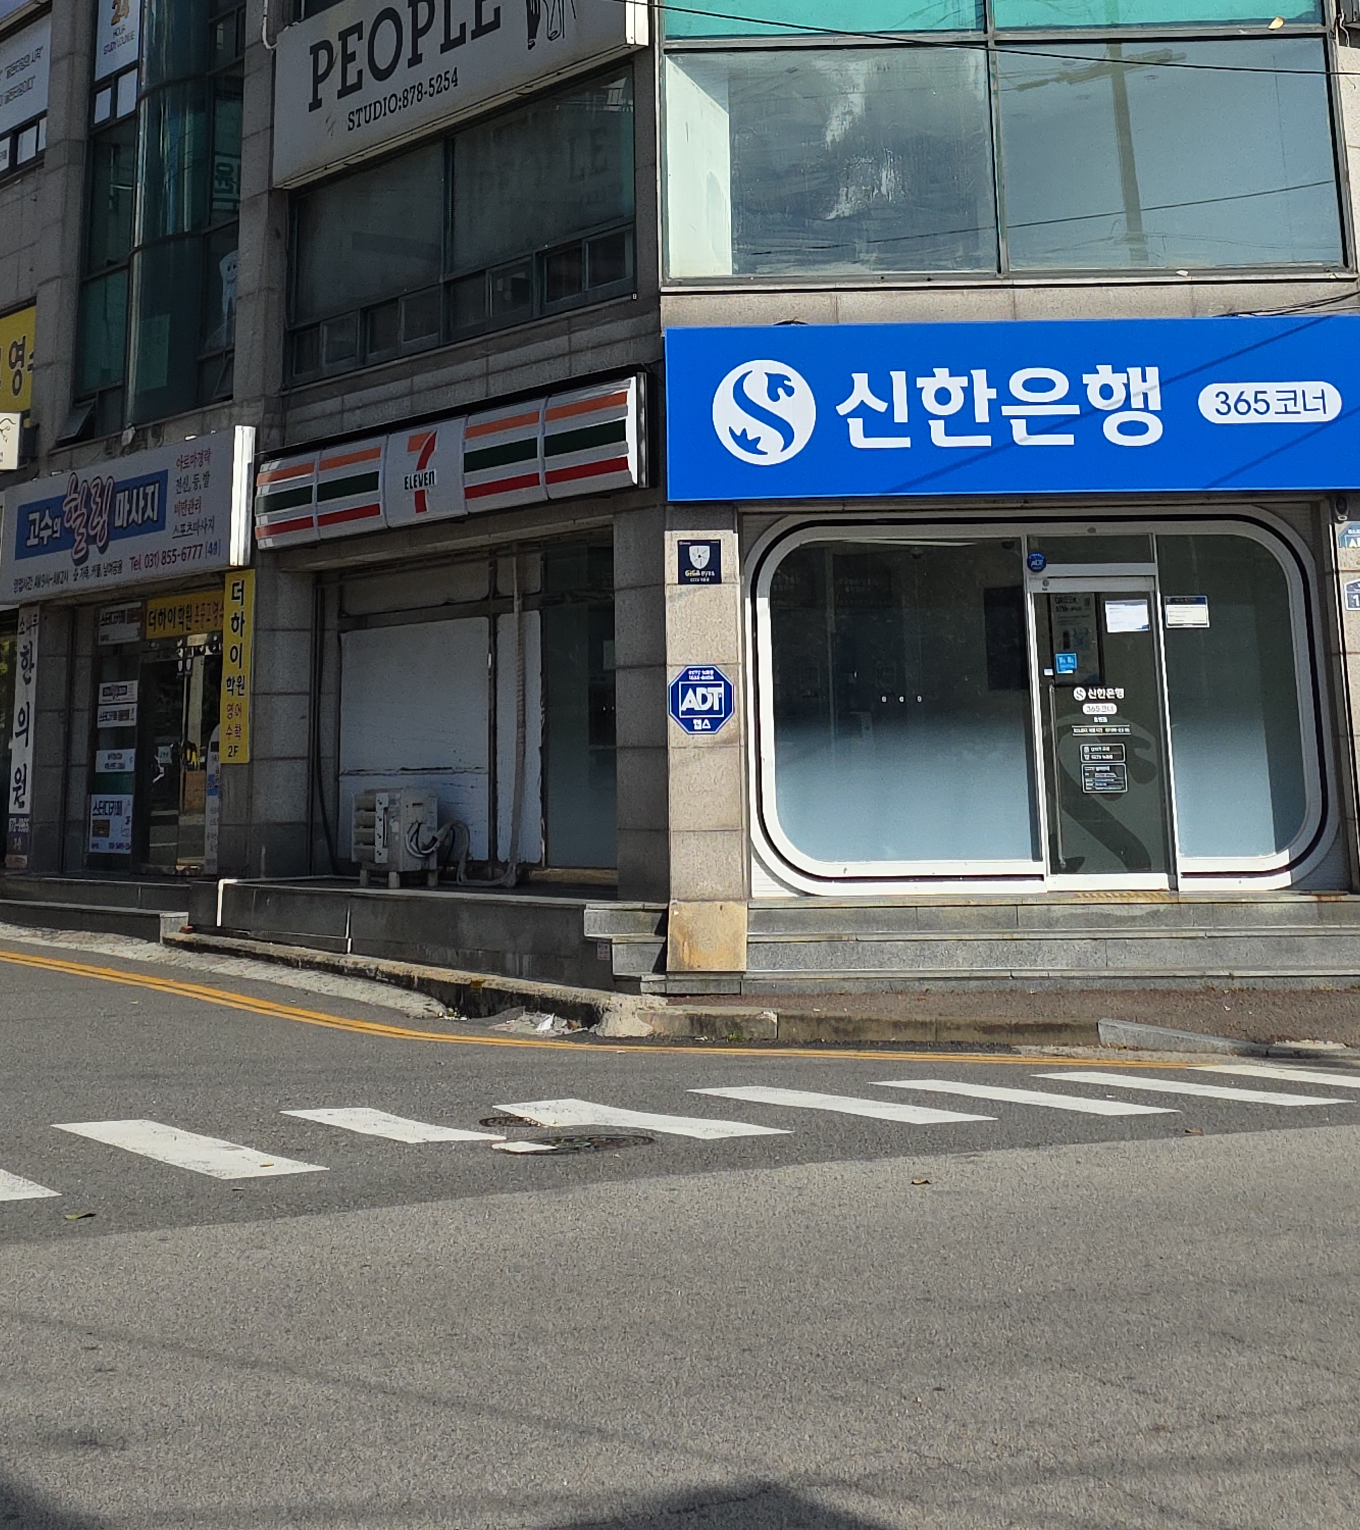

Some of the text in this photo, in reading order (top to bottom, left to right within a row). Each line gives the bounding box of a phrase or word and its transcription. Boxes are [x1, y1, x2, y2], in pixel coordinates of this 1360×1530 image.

[835, 364, 1330, 450] 신한은행 365코너
[115, 483, 160, 529] 마사지
[161, 543, 203, 567] 855-6777
[230, 580, 246, 670] 더하이
[226, 675, 246, 698] 학원
[681, 686, 723, 712] ADT
[11, 640, 35, 809] 한의원
[227, 744, 240, 759] 2F
